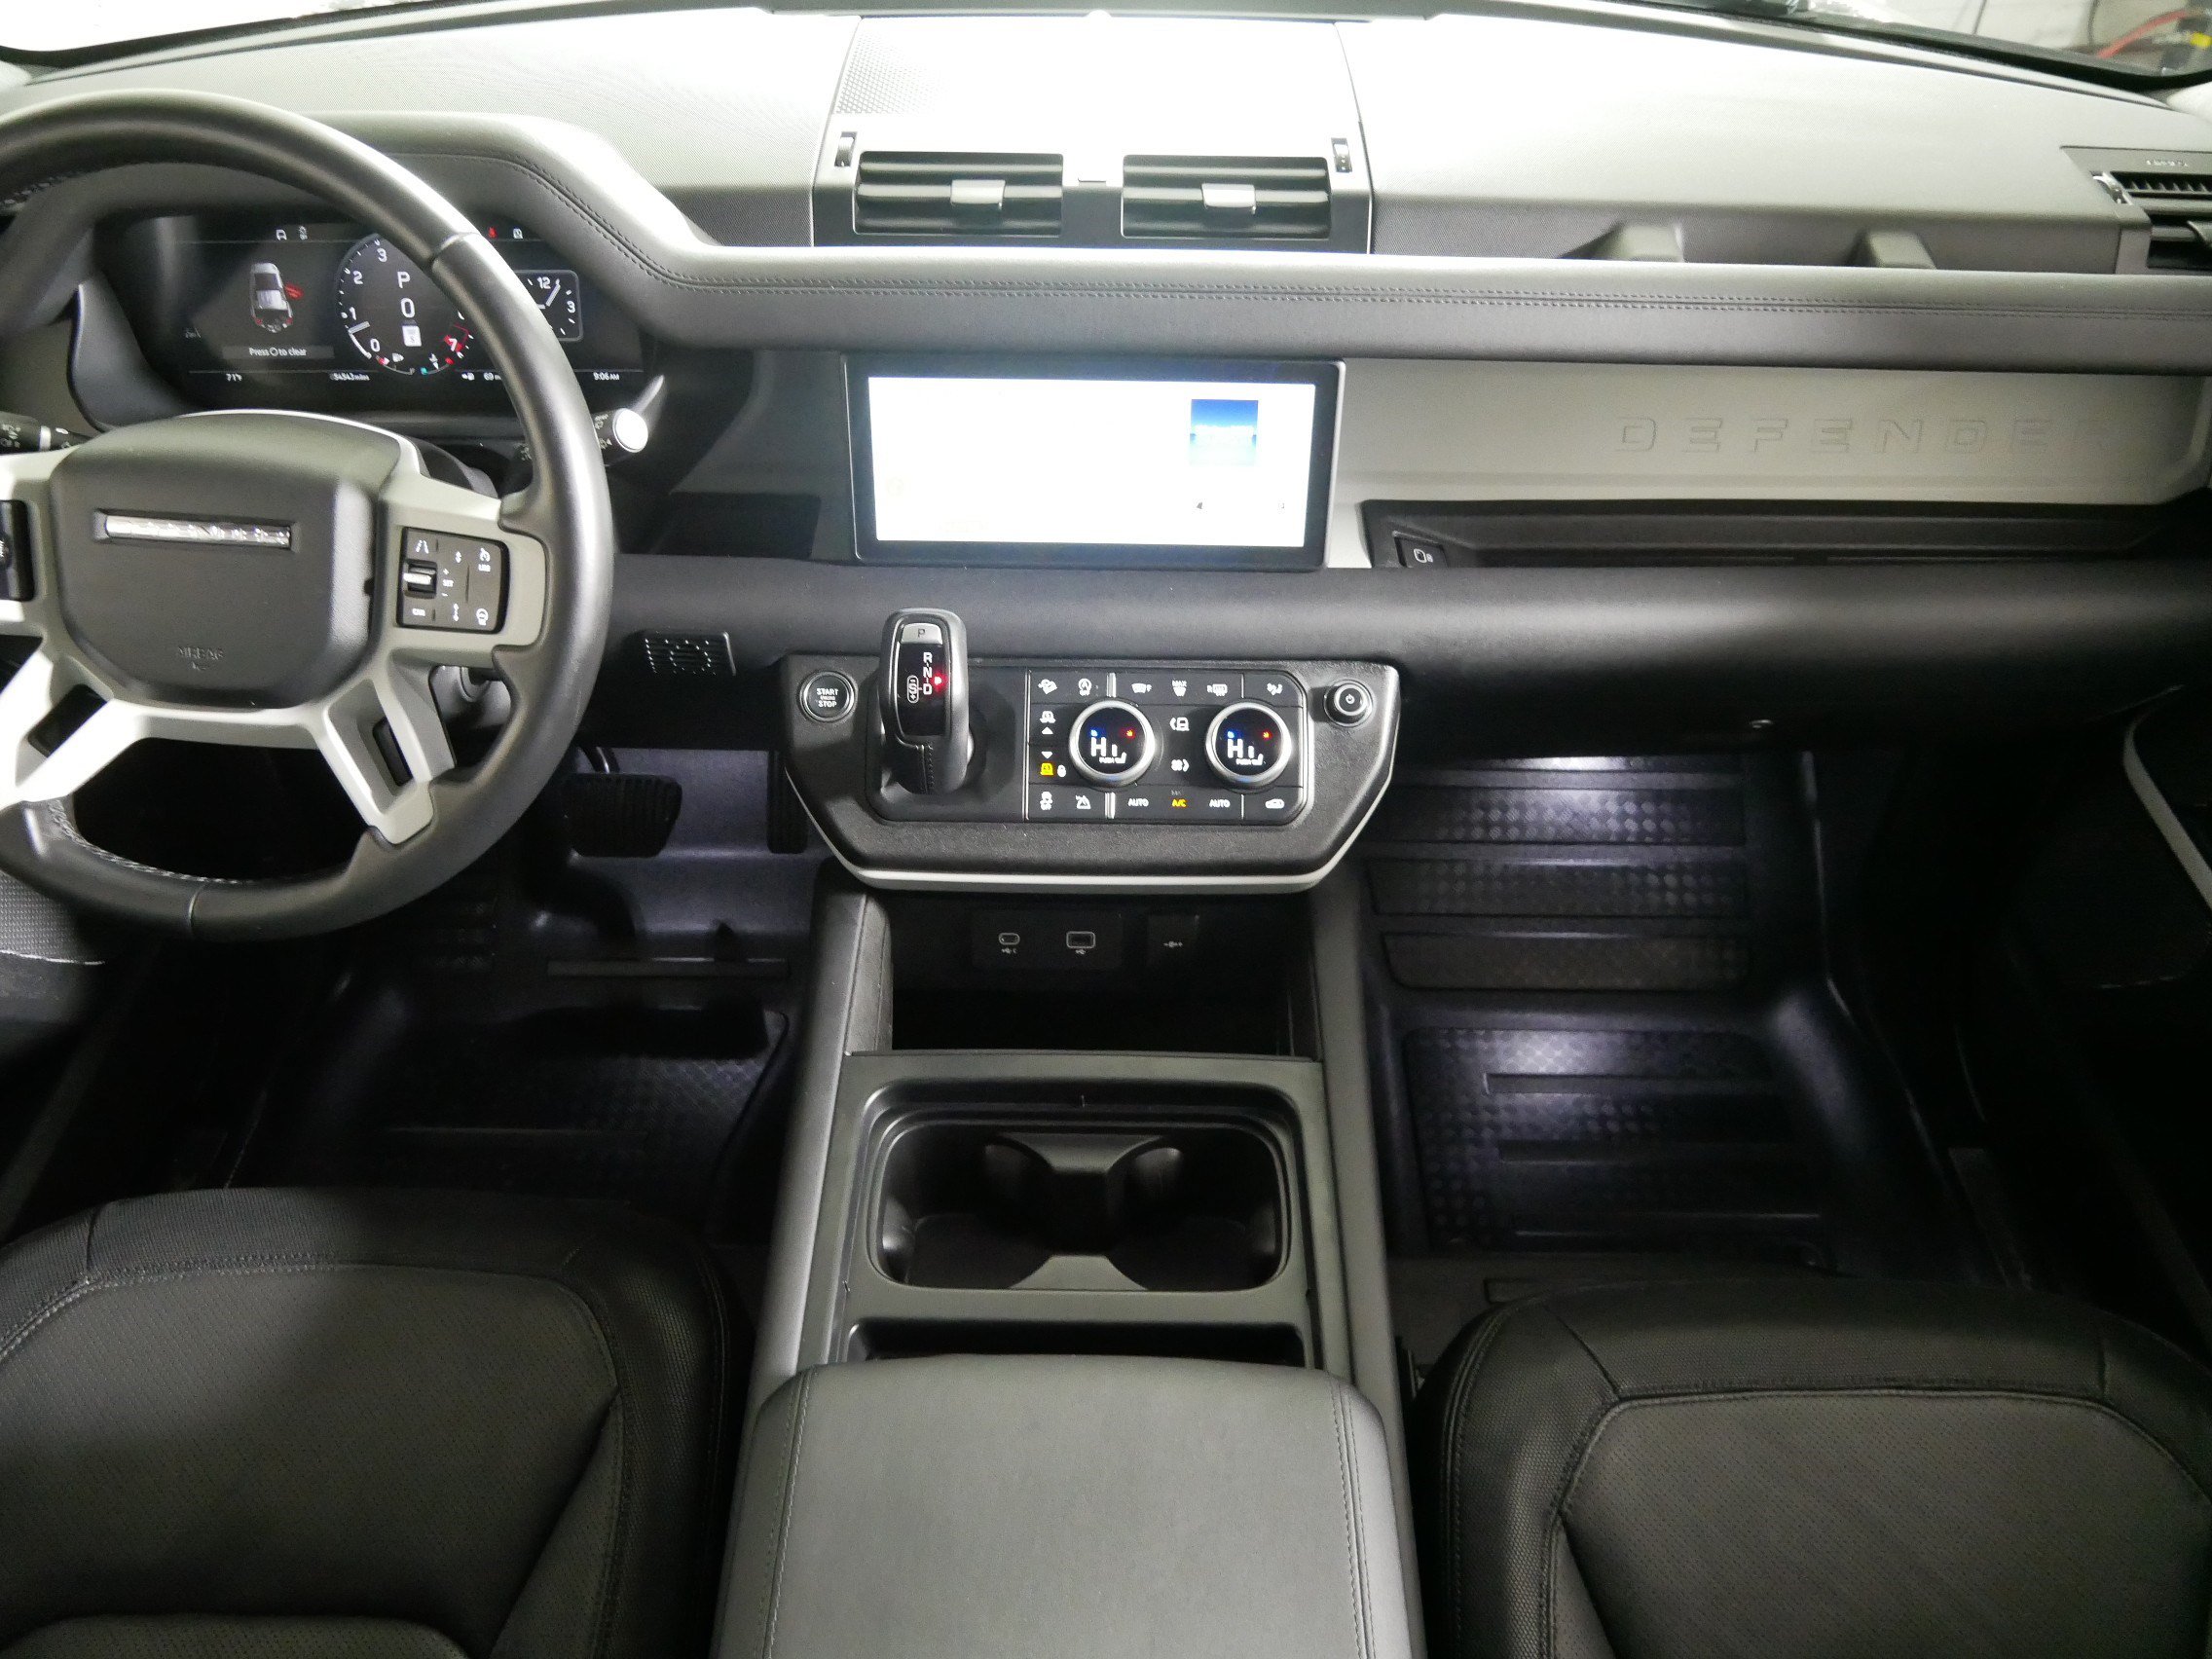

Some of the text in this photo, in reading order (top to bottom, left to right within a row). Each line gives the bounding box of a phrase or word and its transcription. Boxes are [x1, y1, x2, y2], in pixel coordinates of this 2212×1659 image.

[377, 247, 387, 263] 3
[352, 270, 363, 285] 2
[397, 271, 410, 288] P
[536, 276, 551, 289] 12
[400, 297, 416, 318] 0
[567, 300, 575, 313] 3
[350, 306, 357, 321] 1
[370, 338, 381, 352] 0
[918, 628, 926, 638] P
[923, 651, 933, 663] R
[923, 666, 933, 679] N
[816, 687, 839, 696] START
[923, 682, 933, 695] D
[1127, 797, 1150, 807] AUTO
[1171, 798, 1187, 807] A/C
[1208, 798, 1231, 808] AUTO
